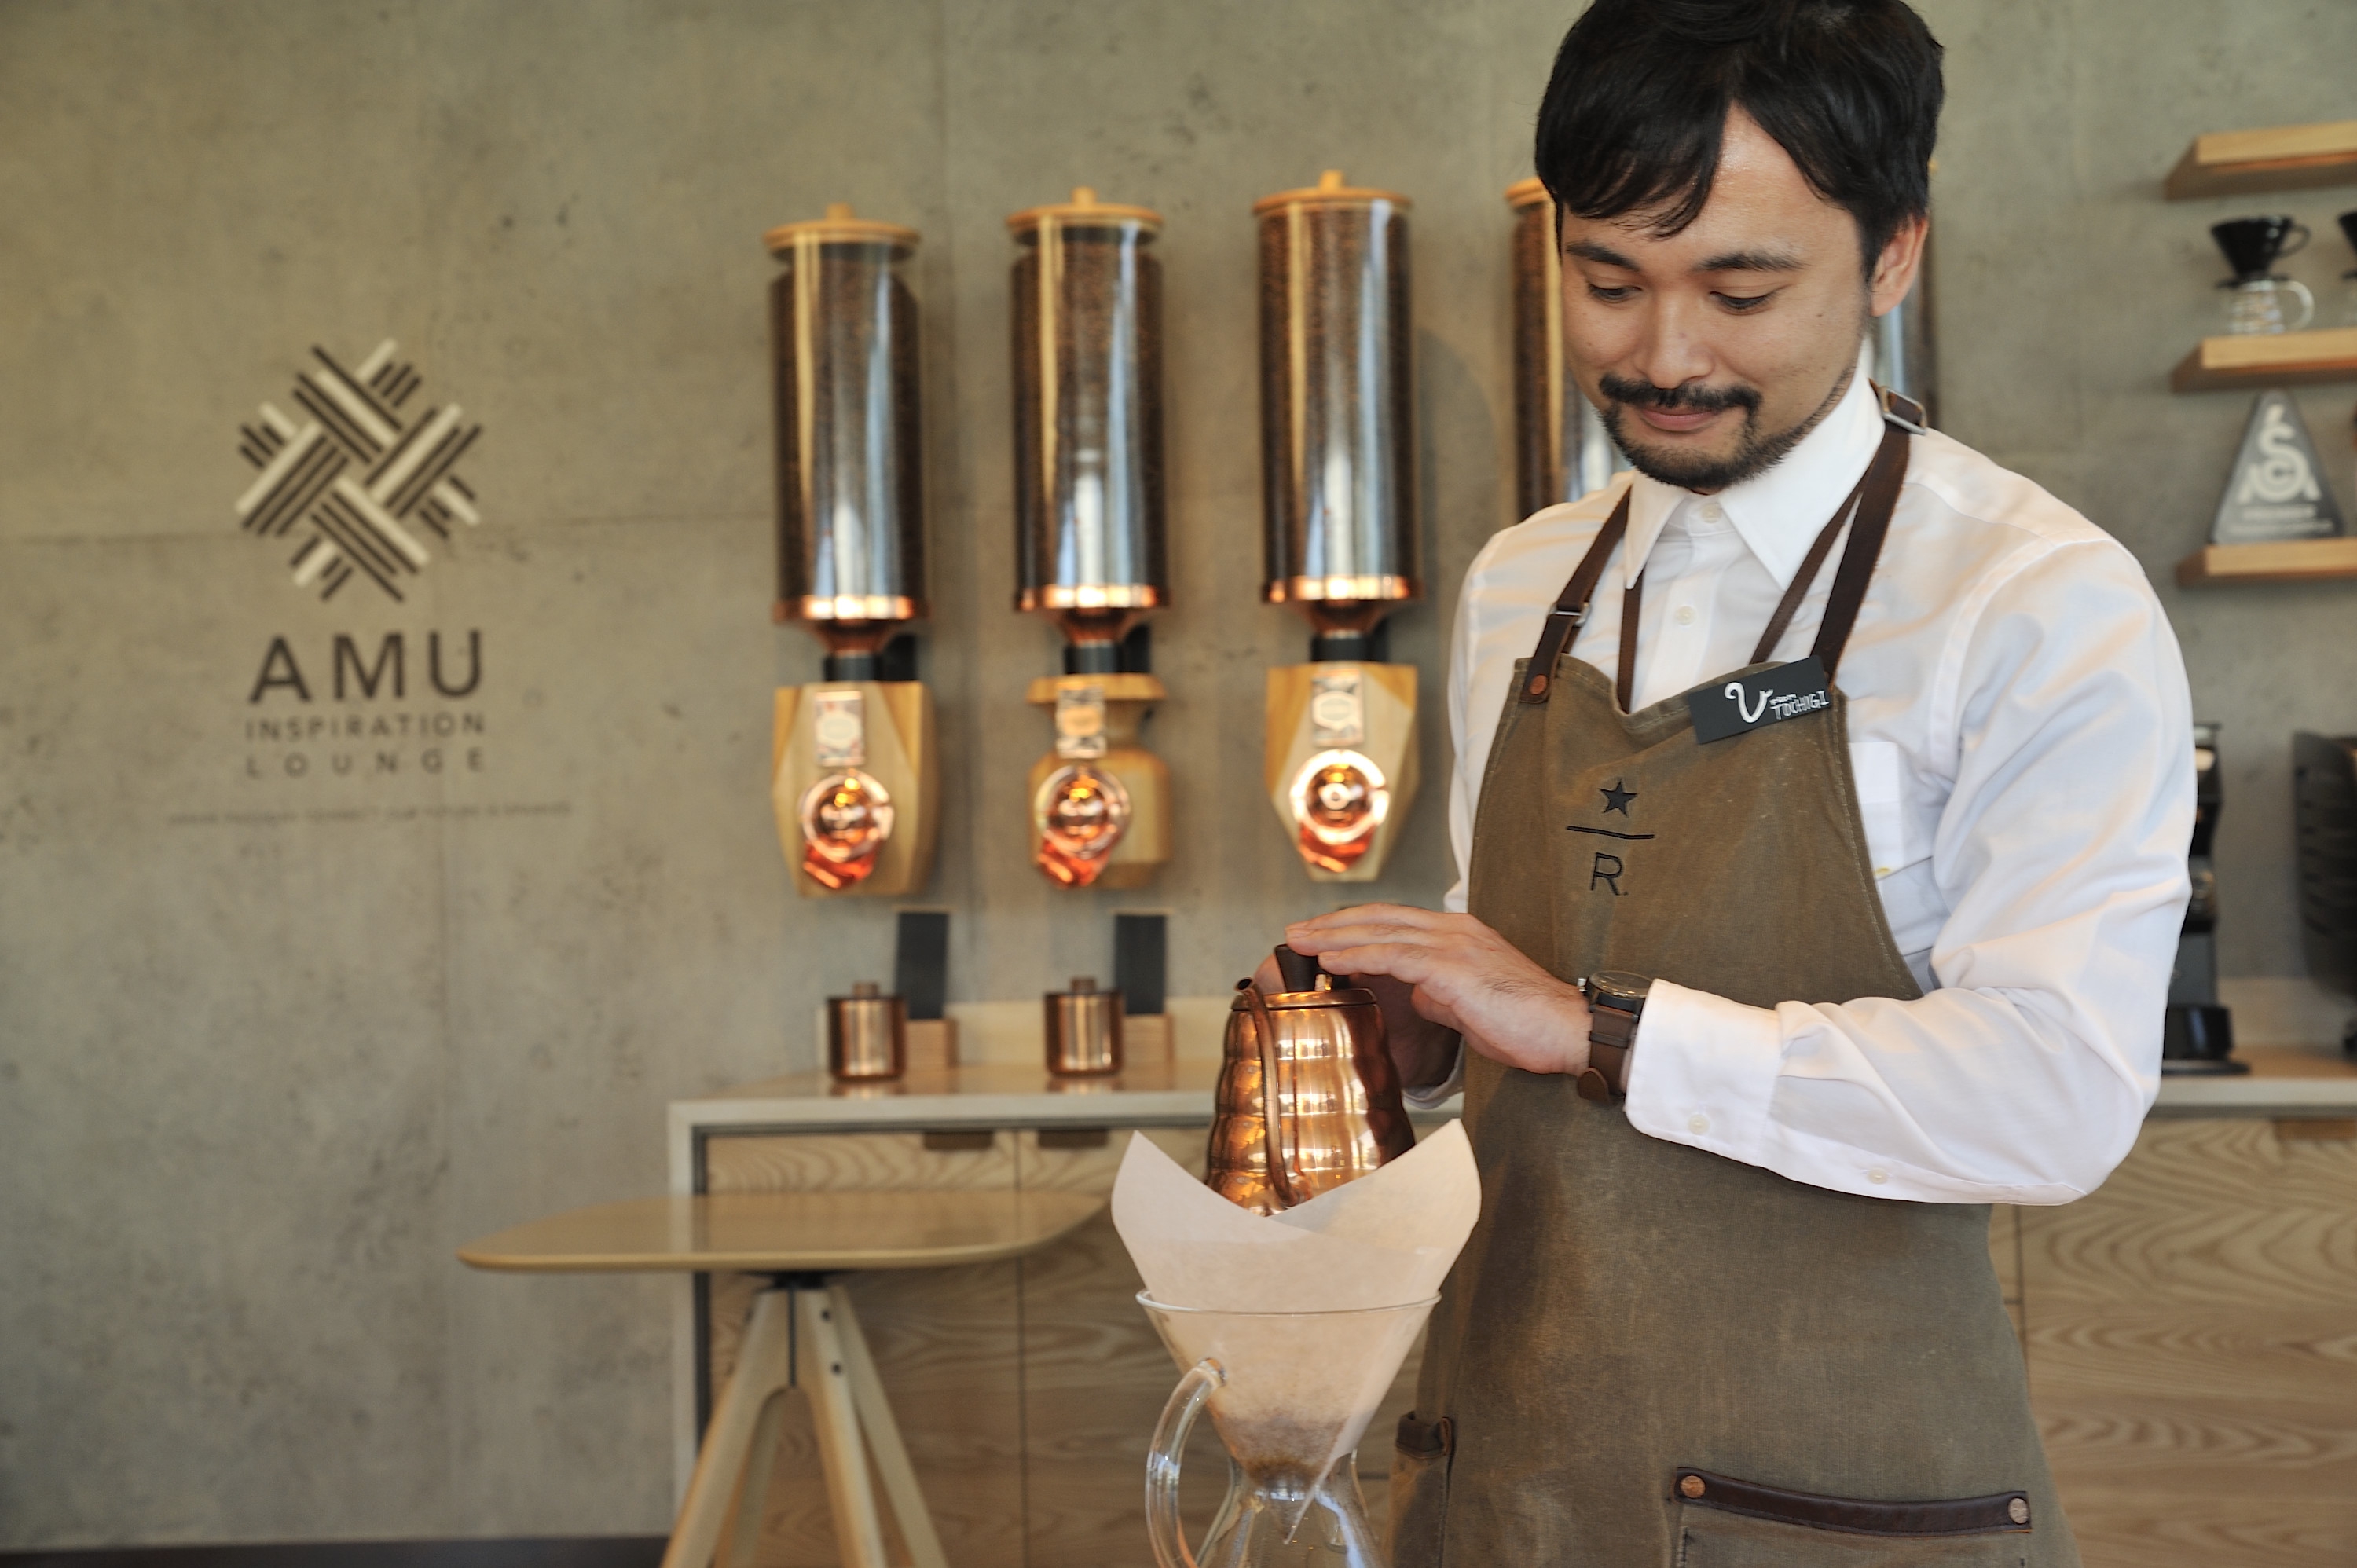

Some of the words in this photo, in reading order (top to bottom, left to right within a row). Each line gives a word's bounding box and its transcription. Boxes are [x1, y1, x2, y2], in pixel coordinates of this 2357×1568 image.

[248, 628, 482, 704] AMU
[1770, 691, 1830, 720] TOCHIGI
[246, 712, 484, 740] INSPIRATION
[246, 748, 483, 778] LOUNGE
